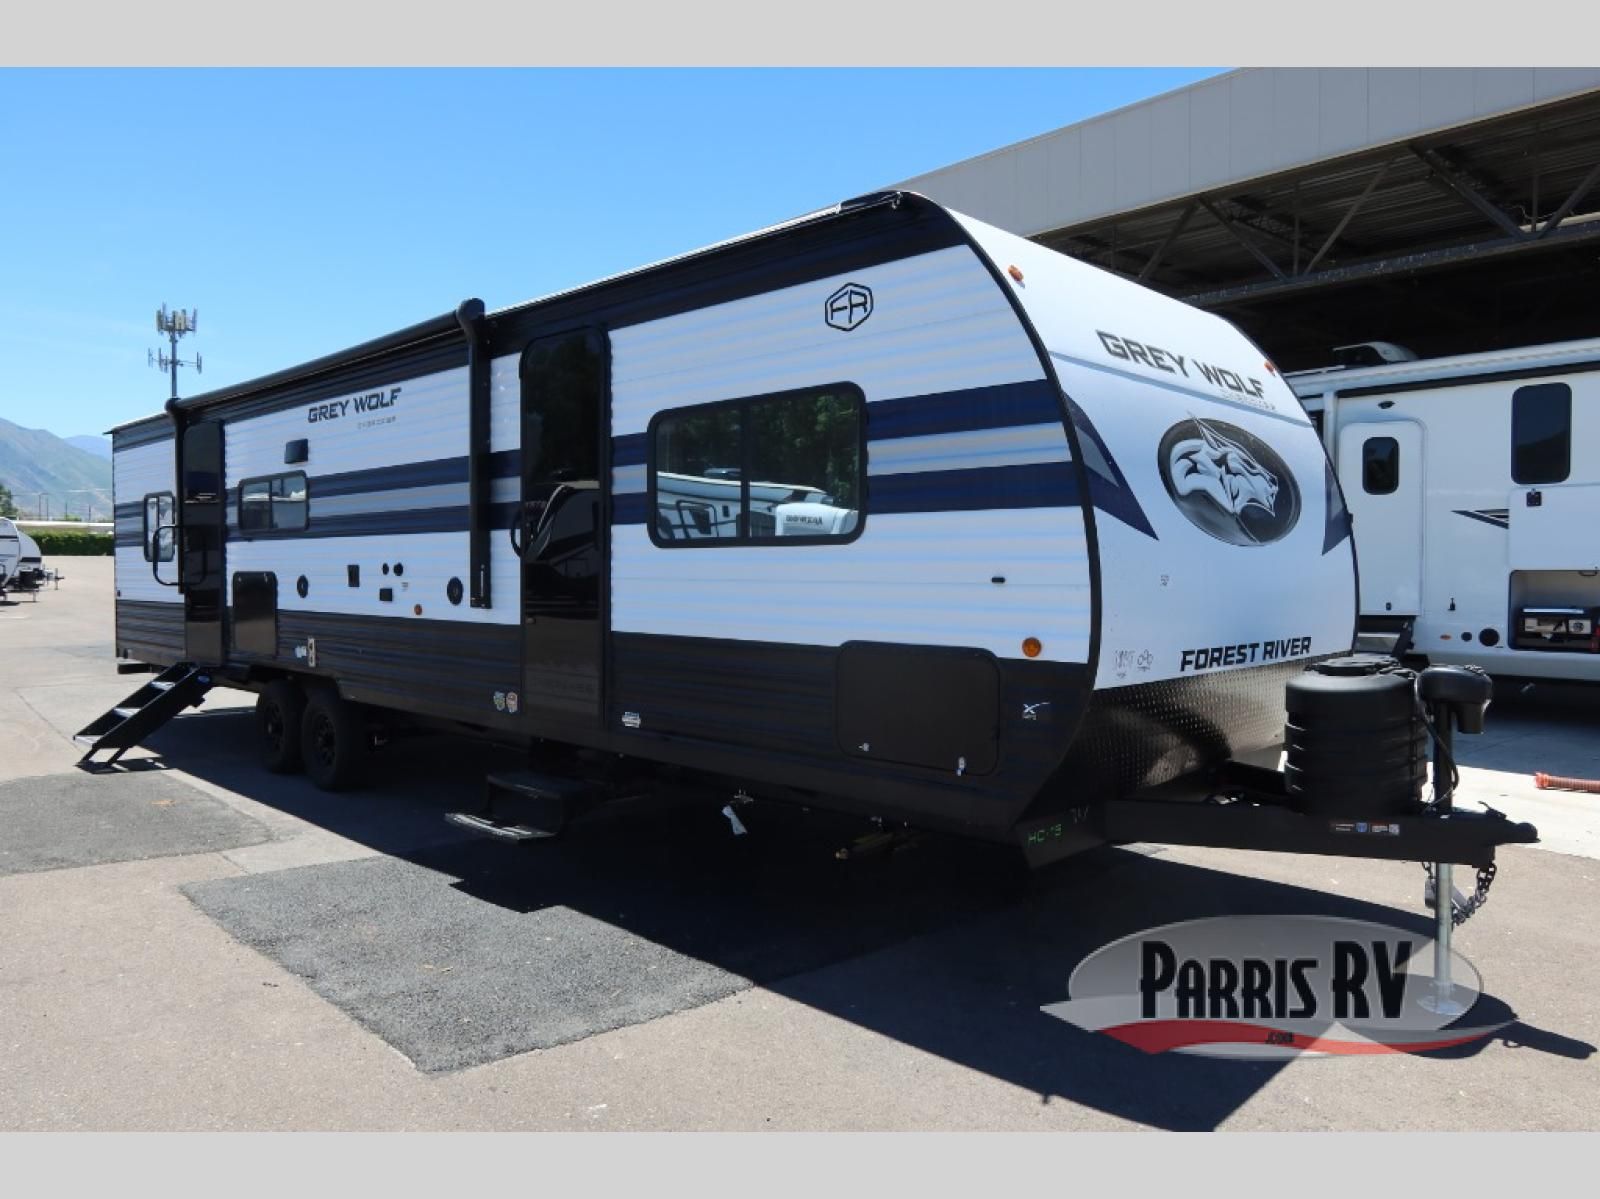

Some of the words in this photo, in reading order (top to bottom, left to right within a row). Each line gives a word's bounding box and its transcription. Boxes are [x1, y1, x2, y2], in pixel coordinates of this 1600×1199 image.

[1096, 329, 1190, 378] GREY
[1191, 358, 1265, 400] WOLF
[307, 399, 350, 423] GREY
[353, 387, 402, 414] WOLF
[1180, 642, 1260, 672] FOREST
[1262, 636, 1312, 661] RIVER
